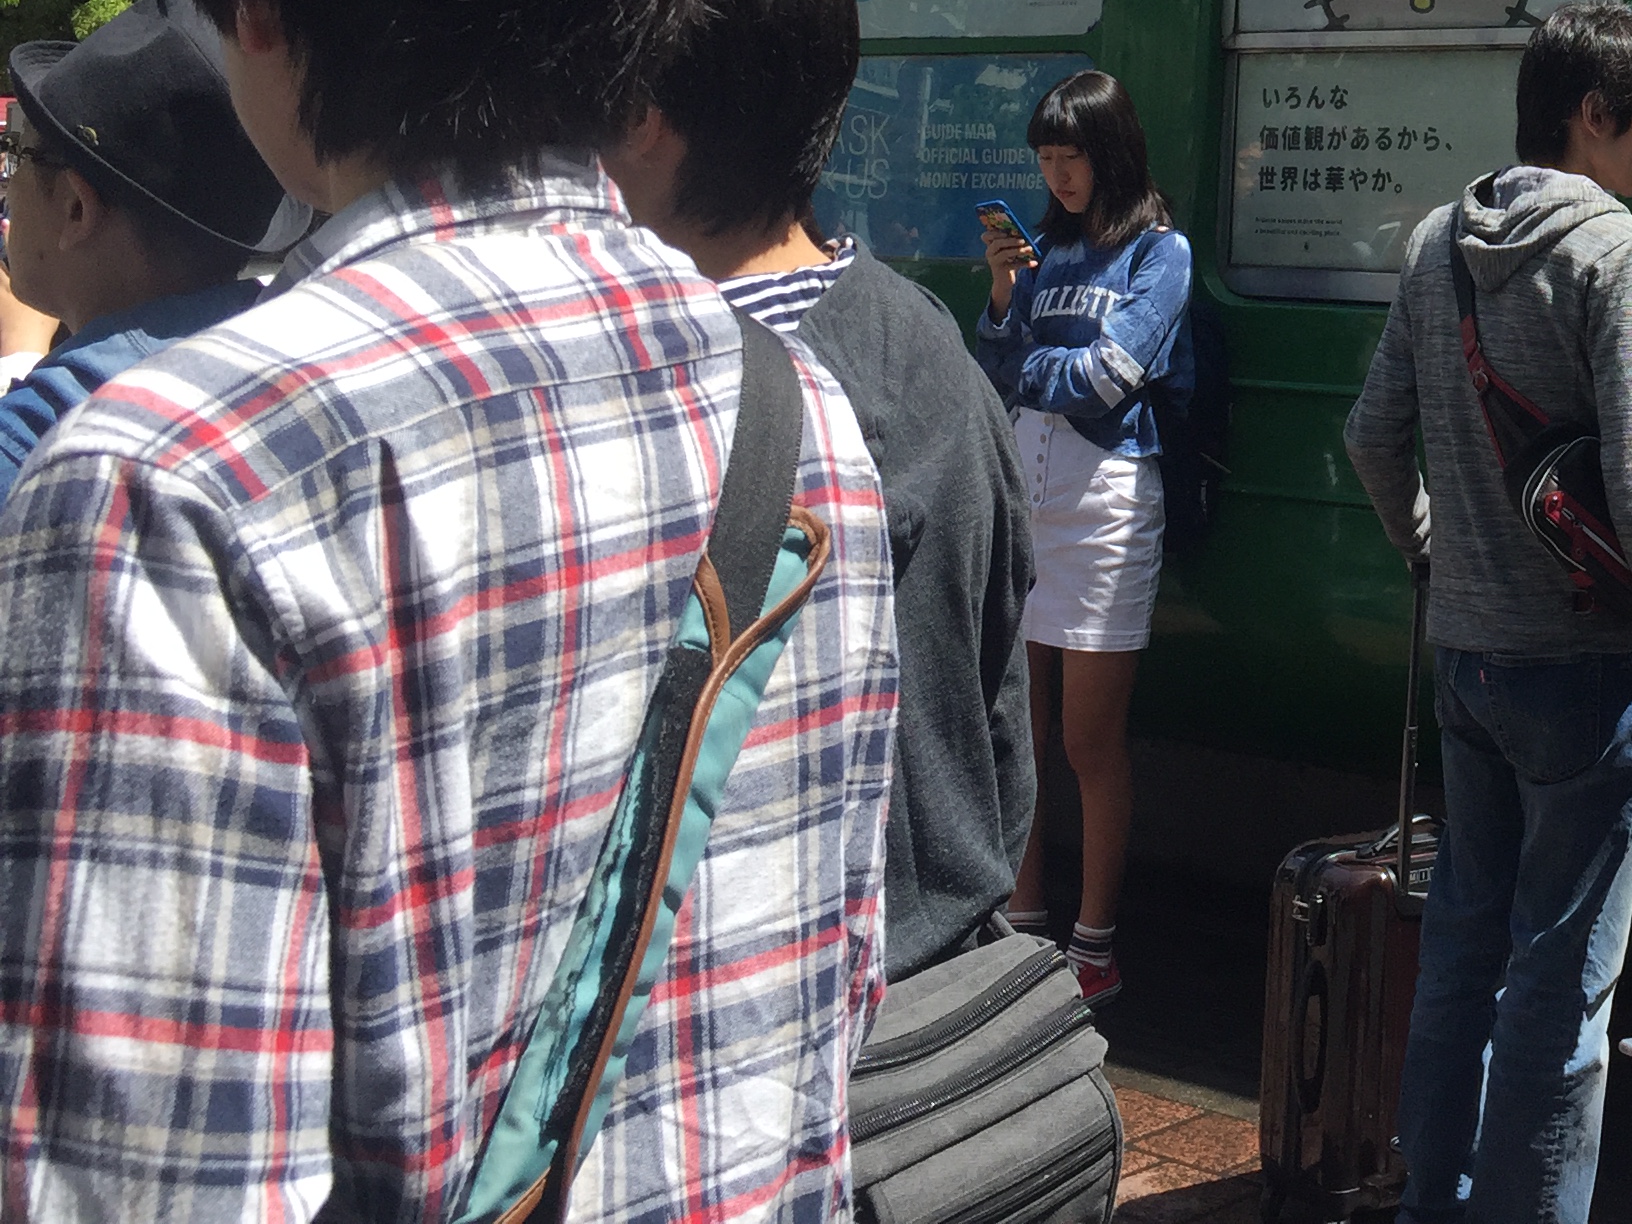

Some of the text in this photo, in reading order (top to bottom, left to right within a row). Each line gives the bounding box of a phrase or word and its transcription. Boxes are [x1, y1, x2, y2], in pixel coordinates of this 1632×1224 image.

[1263, 85, 1349, 110] いろんな
[923, 124, 962, 140] GUIDE
[1259, 125, 1454, 151] 価値観があるから、
[922, 147, 979, 164] OFFICIAL
[982, 149, 1024, 164] GUIDE
[846, 159, 889, 200] US
[919, 172, 967, 189] MONEY
[1258, 166, 1403, 194] 世界は華やか。
